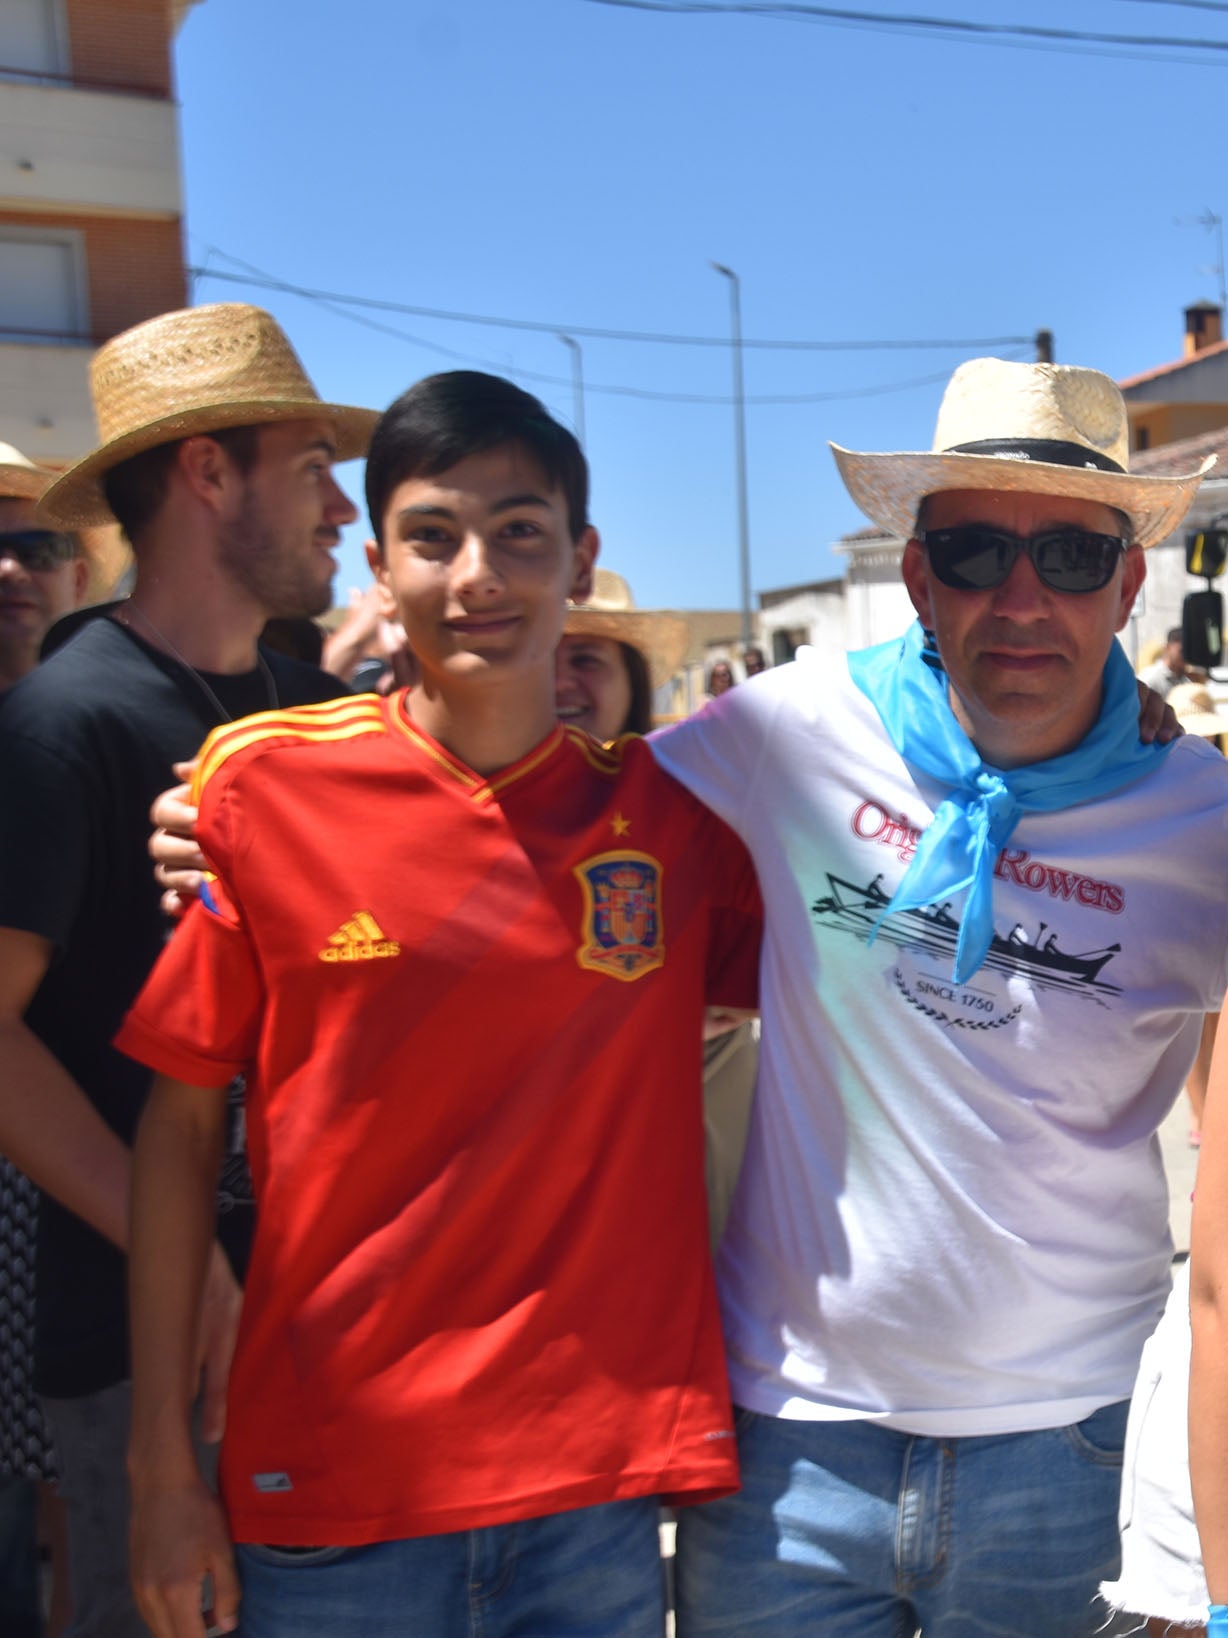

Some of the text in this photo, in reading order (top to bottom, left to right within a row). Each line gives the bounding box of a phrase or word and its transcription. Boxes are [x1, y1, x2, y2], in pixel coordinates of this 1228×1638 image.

[993, 847, 1126, 915] Rowers
[318, 940, 400, 962] adidas
[916, 980, 994, 1013] SINCE 1750
